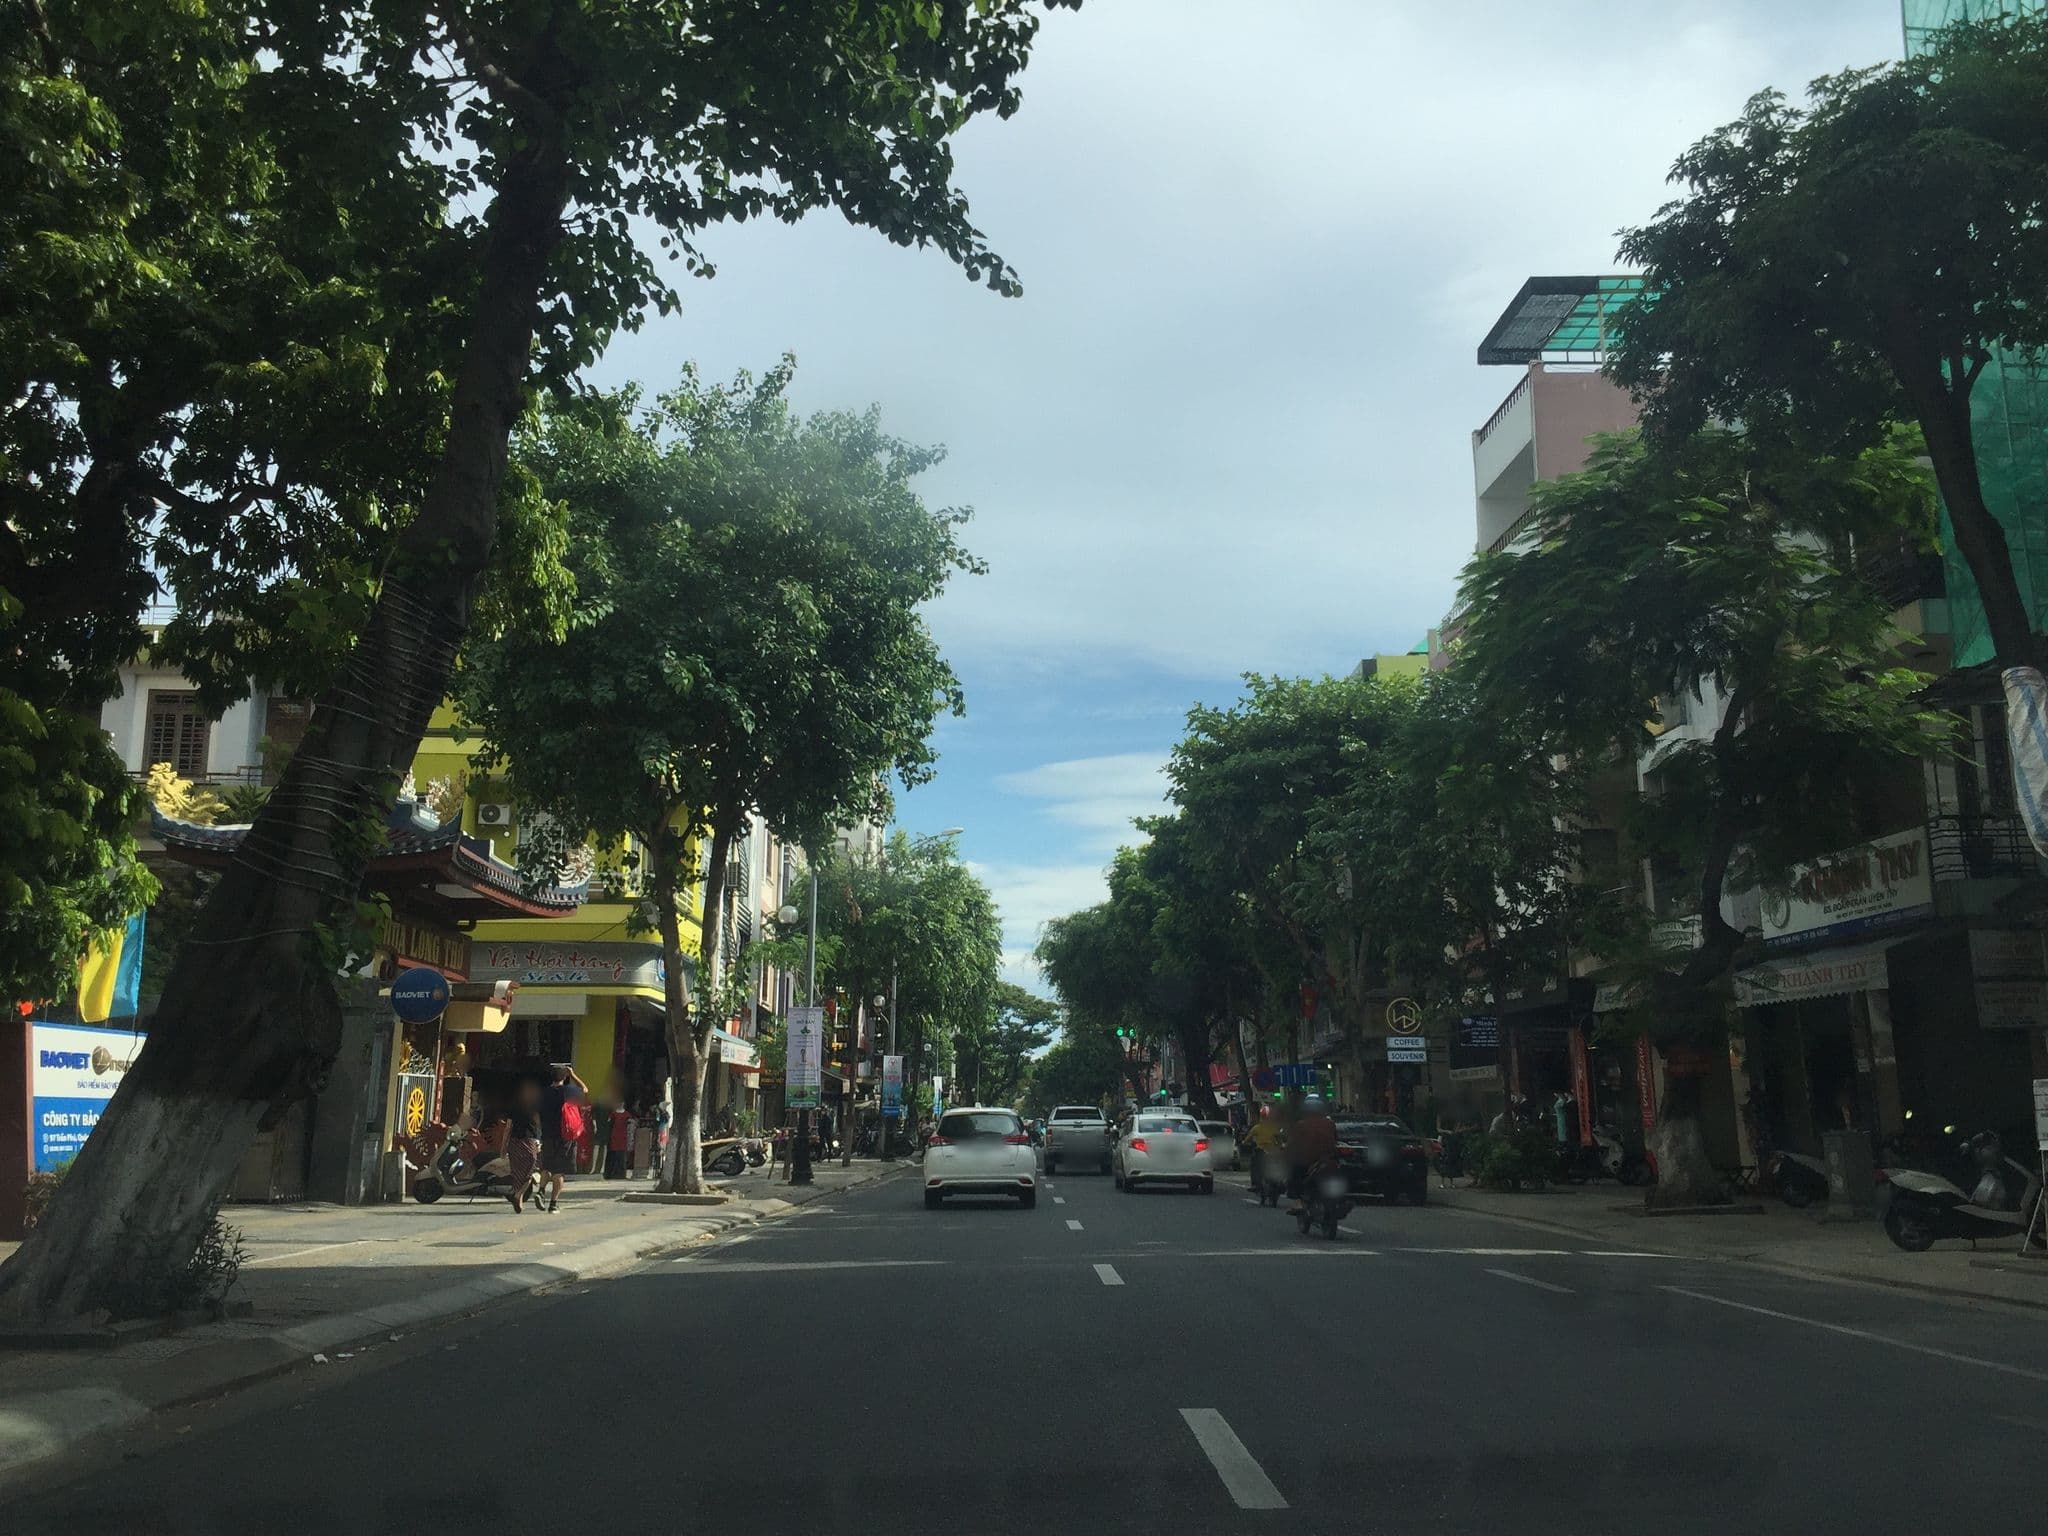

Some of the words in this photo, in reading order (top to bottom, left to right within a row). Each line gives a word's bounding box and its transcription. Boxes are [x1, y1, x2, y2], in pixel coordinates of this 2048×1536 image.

[568, 950, 625, 981] trang
[395, 991, 431, 999] BAOVIET
[1394, 1038, 1421, 1046] COFFEE
[40, 1050, 90, 1070] BAOVIET
[1391, 1052, 1425, 1060] SOUVENIR
[43, 1110, 68, 1127] CÔNG
[69, 1113, 81, 1126] TY
